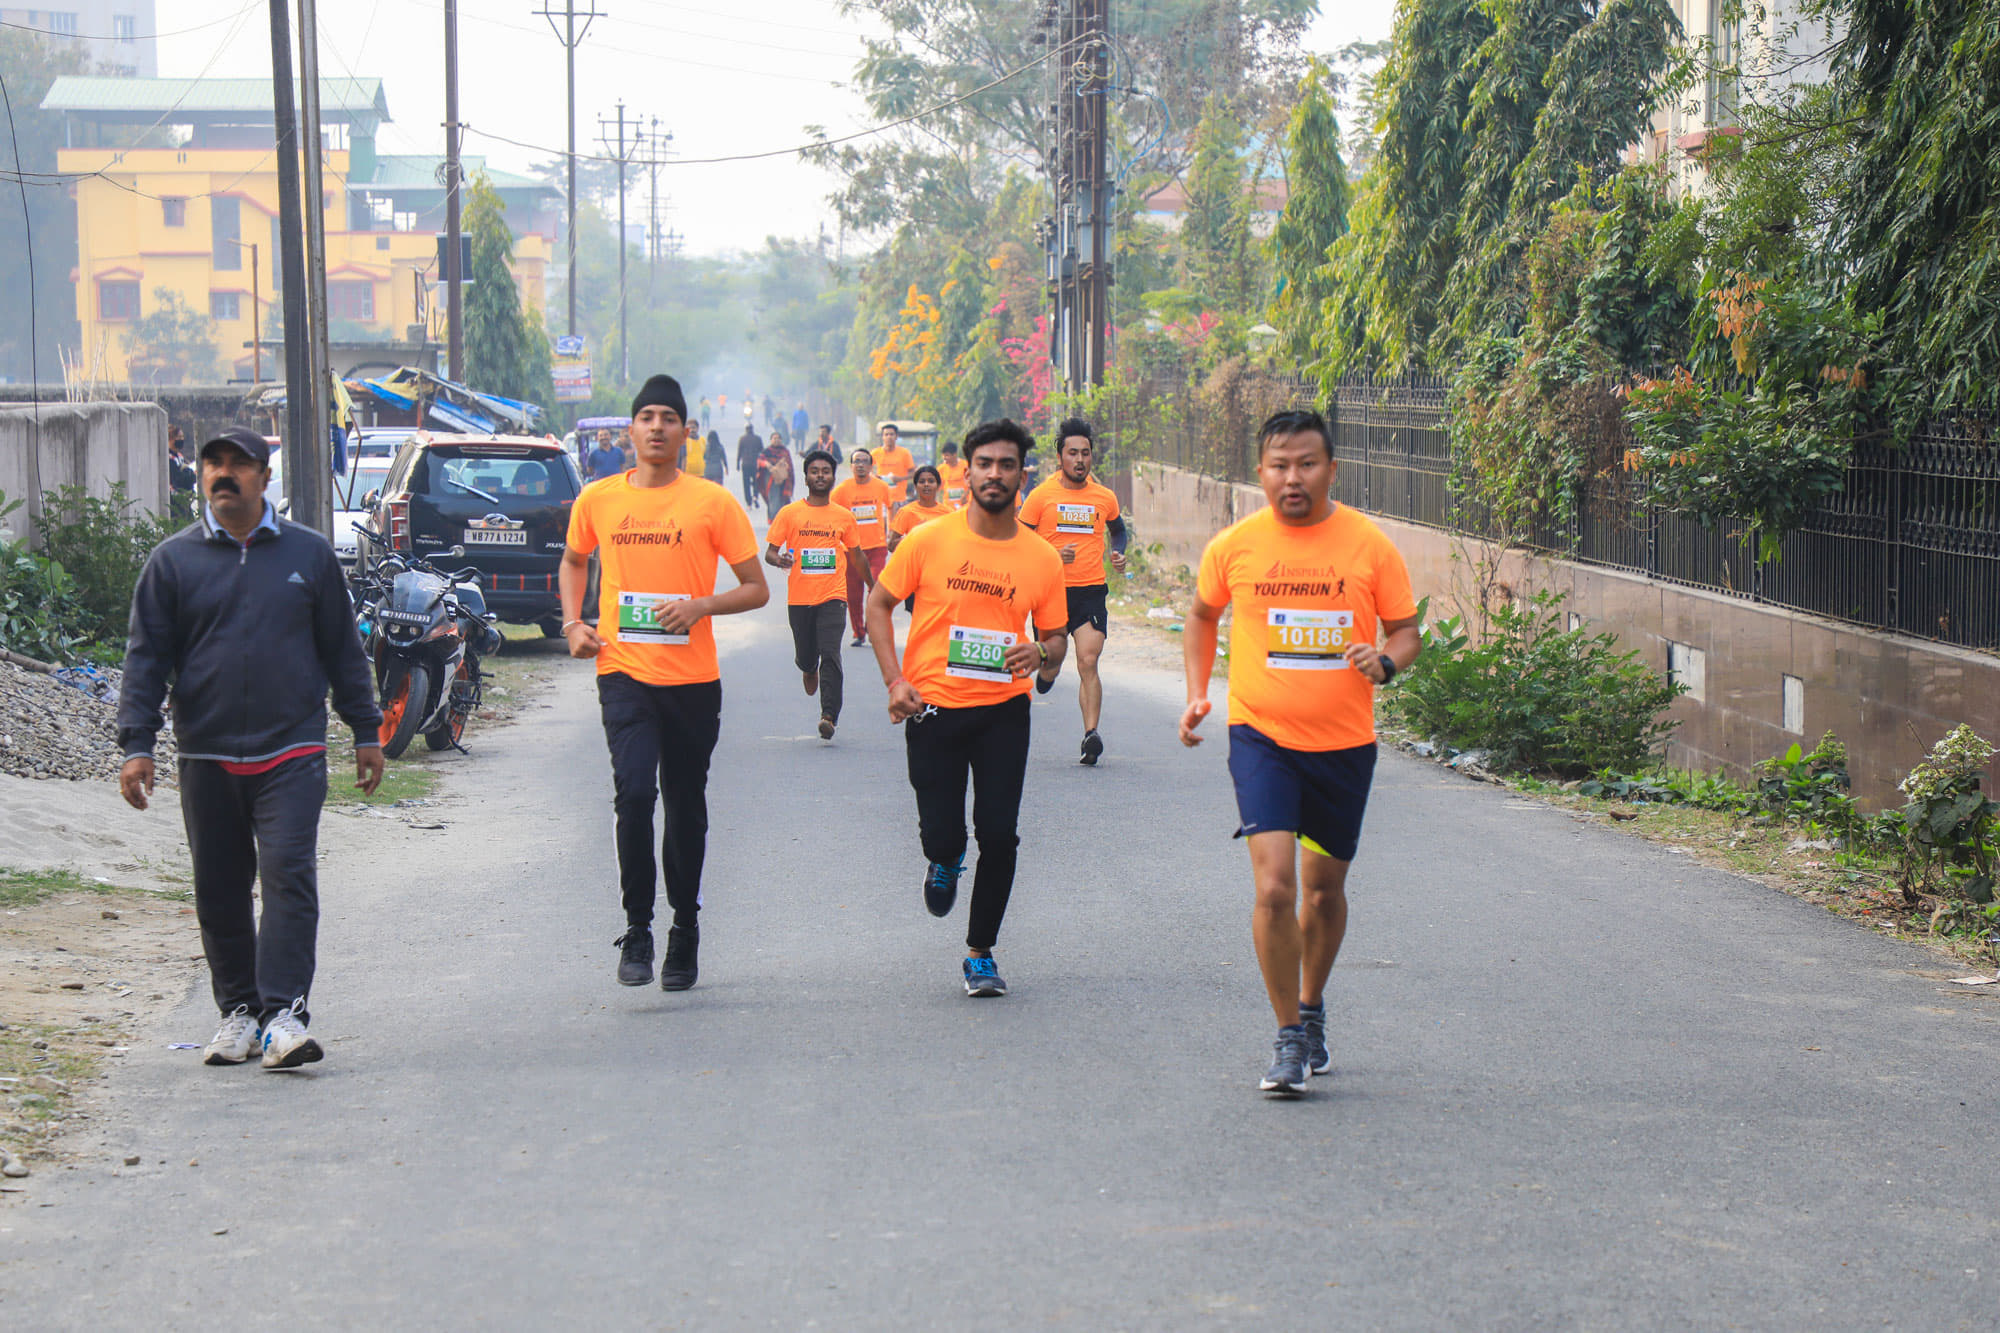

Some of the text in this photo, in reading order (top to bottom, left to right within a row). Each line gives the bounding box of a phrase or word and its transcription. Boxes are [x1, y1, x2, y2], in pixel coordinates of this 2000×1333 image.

[1063, 511, 1090, 522] 10258
[611, 532, 672, 545] YOUTHRUN
[799, 529, 831, 538] YOUTHRUN
[807, 554, 830, 564] 5498
[946, 577, 1006, 599] YOUTHRUN
[1254, 582, 1332, 597] YOUTHRUN
[1278, 626, 1344, 647] 10186
[960, 641, 1002, 662] 5260
